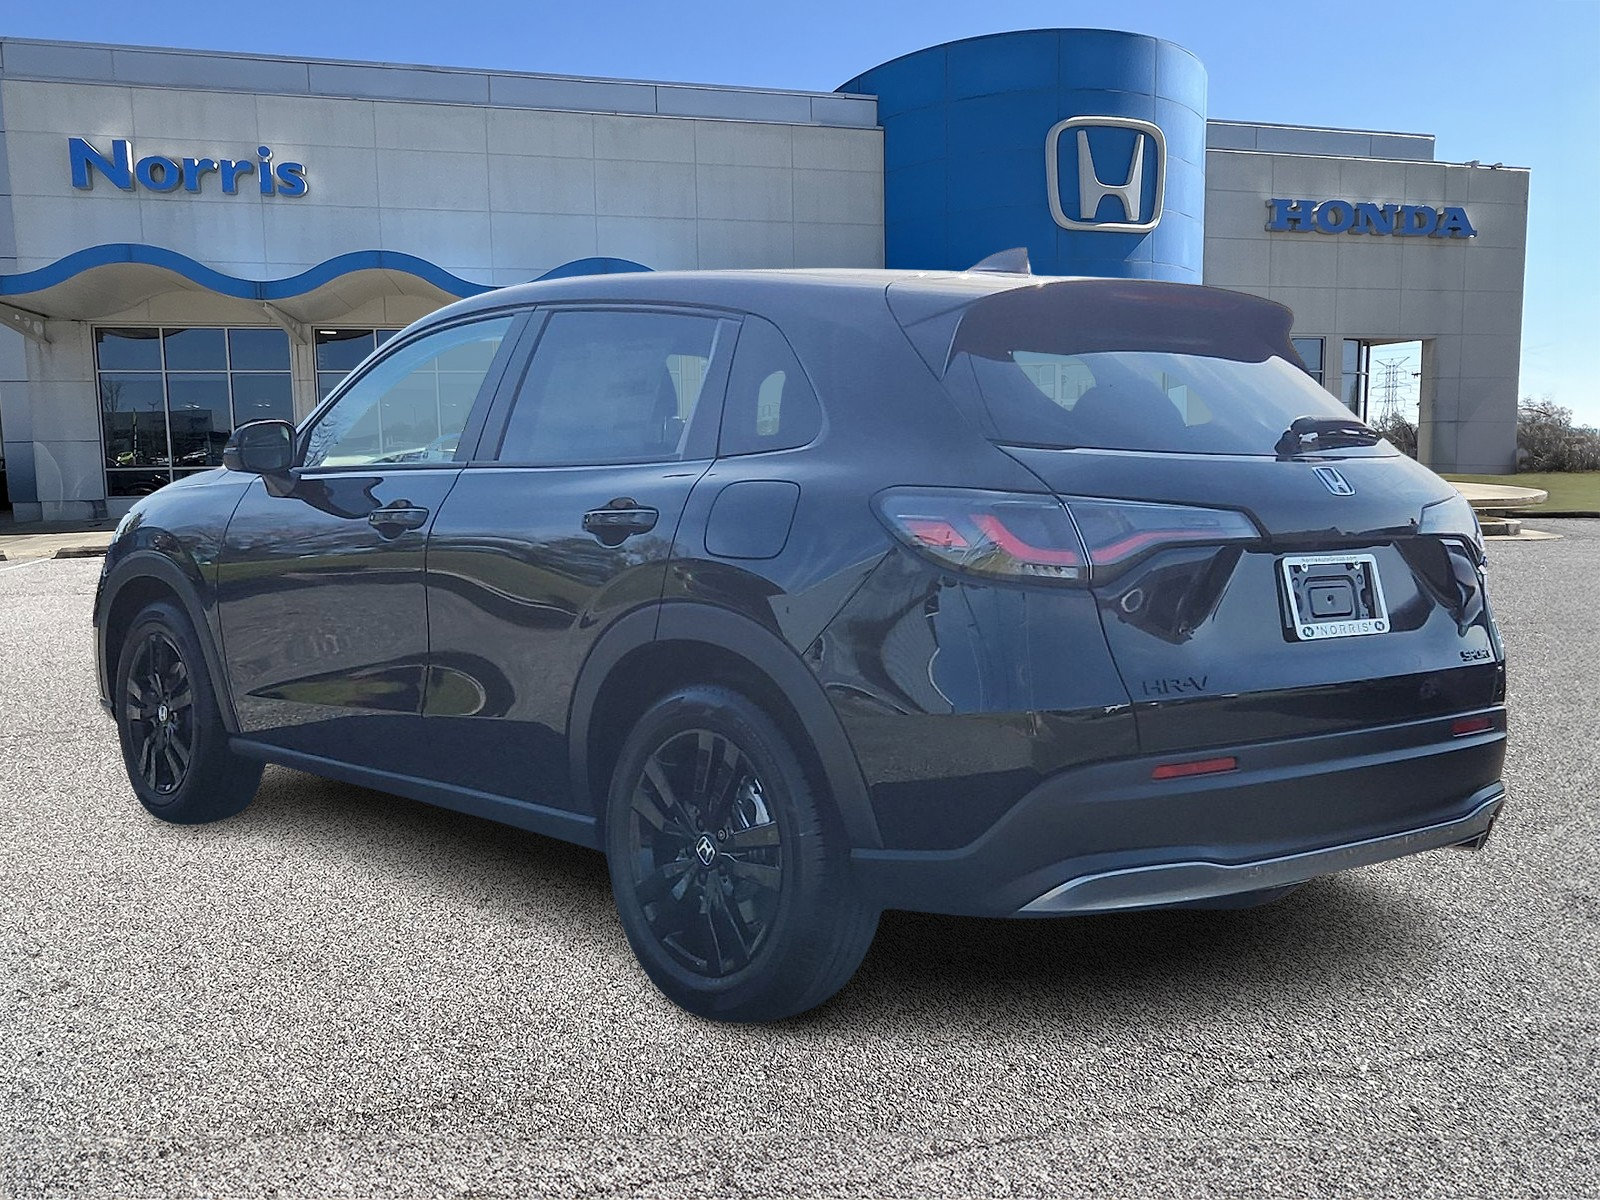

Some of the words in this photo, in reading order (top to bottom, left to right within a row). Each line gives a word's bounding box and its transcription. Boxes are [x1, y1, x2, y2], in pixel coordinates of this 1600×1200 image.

[68, 137, 308, 197] Norris
[1266, 198, 1477, 239] HONDA
[1142, 675, 1208, 696] HR-V
